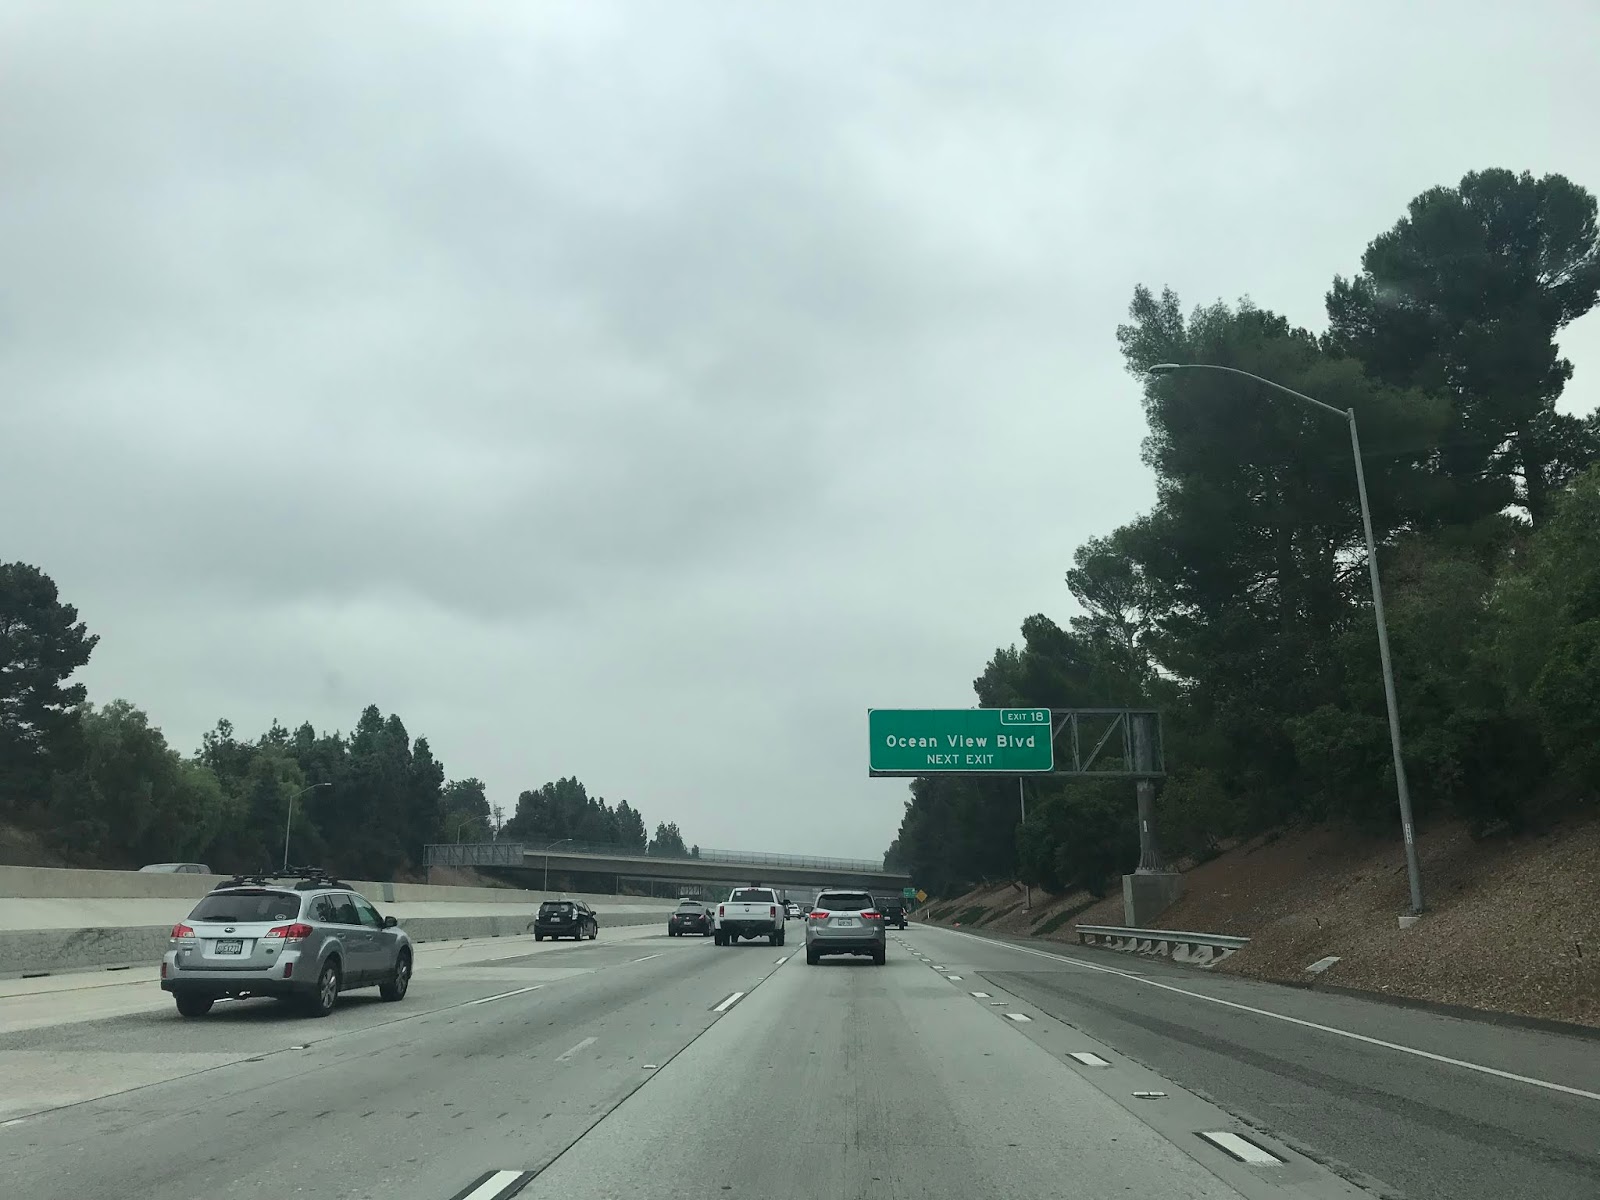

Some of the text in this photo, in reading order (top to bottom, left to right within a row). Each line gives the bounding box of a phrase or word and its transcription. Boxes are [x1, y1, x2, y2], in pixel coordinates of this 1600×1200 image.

[1007, 712, 1044, 722] EXIT 18
[886, 735, 1036, 748] Ocean View Blvd
[927, 754, 994, 764] NEXT EXIT
